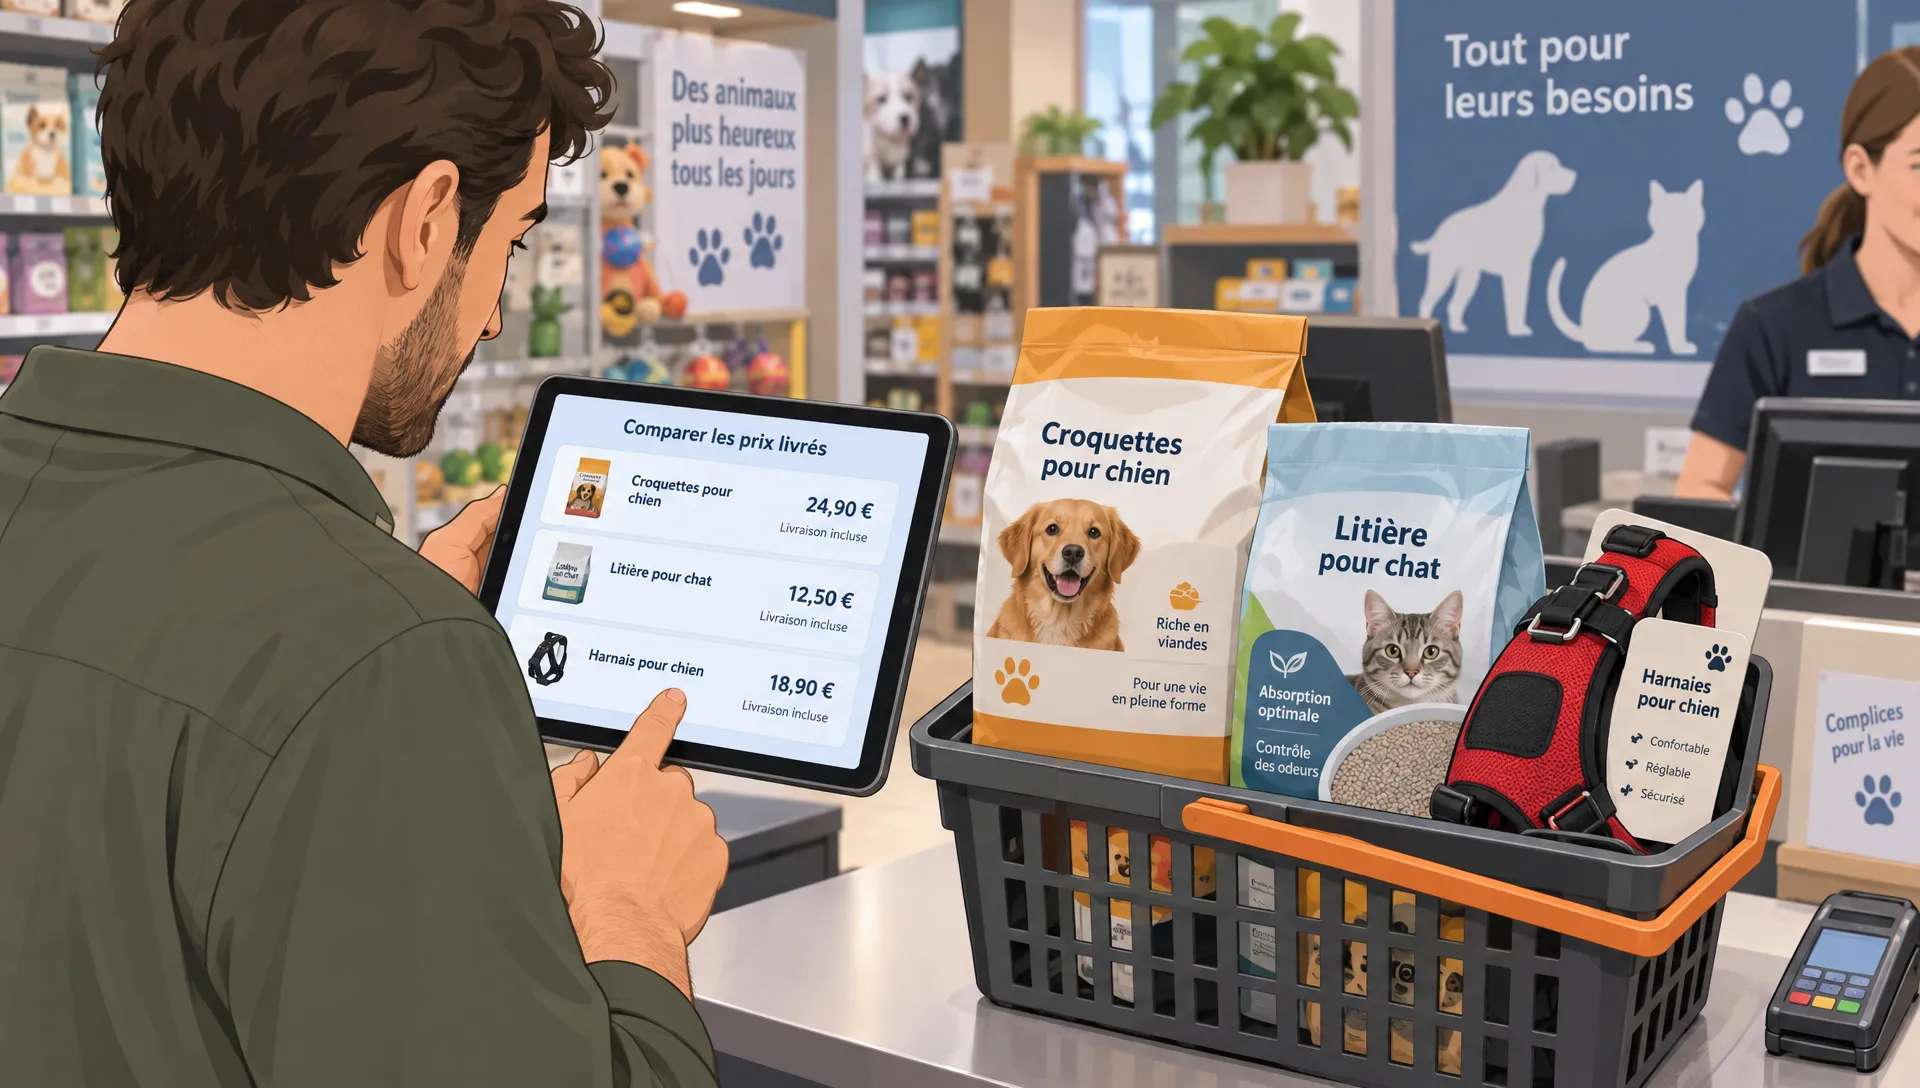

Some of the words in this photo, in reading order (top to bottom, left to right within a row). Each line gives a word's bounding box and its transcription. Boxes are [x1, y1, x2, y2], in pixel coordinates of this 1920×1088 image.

[1445, 33, 1527, 68] Tout
[1540, 33, 1630, 73] pour
[672, 70, 709, 103] Des
[715, 78, 796, 111] animaux
[1446, 83, 1534, 118] leurs
[1547, 74, 1693, 115] besoins
[672, 114, 712, 152] plus
[719, 115, 796, 149] heureux
[671, 160, 712, 187] tous
[719, 157, 744, 187] les
[748, 159, 795, 196] jours
[624, 419, 707, 442] Comparer
[711, 428, 735, 445] les
[739, 434, 774, 450] prix
[779, 436, 827, 456] livrés
[1042, 422, 1182, 455] Croquettes
[1041, 459, 1100, 480] pour
[1106, 460, 1170, 485] chien
[632, 475, 699, 493] Croquettes
[701, 485, 733, 498] pour
[629, 492, 661, 506] chien
[806, 497, 856, 517] 24,90
[861, 503, 874, 519] €
[780, 523, 827, 537] Livraison
[830, 528, 867, 542] incluse
[1335, 516, 1427, 547] Litière
[610, 562, 648, 578] Litière
[650, 570, 682, 583] pour
[685, 572, 712, 586] chat
[1319, 553, 1379, 575] pour
[1385, 554, 1440, 579] chat
[790, 586, 837, 606] 12,50
[841, 593, 854, 609] €
[760, 611, 807, 626] Livraison
[810, 619, 848, 633] incluse
[1156, 616, 1190, 632] Riche
[1193, 622, 1209, 633] en
[1158, 636, 1208, 652] viandes
[589, 649, 635, 666] Harnais
[637, 658, 669, 672] pour
[671, 662, 704, 677] chien
[771, 675, 817, 696] 18,90
[822, 683, 835, 699] €
[1133, 677, 1161, 691] Pour
[1163, 683, 1186, 694] une
[1189, 684, 1207, 695] vie
[1643, 669, 1711, 693] Harnaies
[1111, 694, 1127, 705] en
[1129, 694, 1167, 709] pleine
[1170, 697, 1206, 711] forme
[1259, 685, 1330, 705] Absorption
[1638, 694, 1676, 710] pour
[1679, 698, 1719, 718] chien
[742, 700, 788, 716] Livraison
[791, 709, 829, 724] incluse
[1259, 706, 1319, 722] optimale
[1826, 705, 1903, 733] Complices
[1256, 740, 1310, 759] Contrôle
[1651, 736, 1709, 755] Confortable
[1832, 741, 1864, 763] pour
[1868, 734, 1880, 751] la
[1884, 730, 1904, 748] vie
[1255, 758, 1274, 772] des
[1278, 762, 1318, 777] odeurs
[1646, 762, 1690, 779] Réglable
[1641, 789, 1684, 805] Sécurisé
